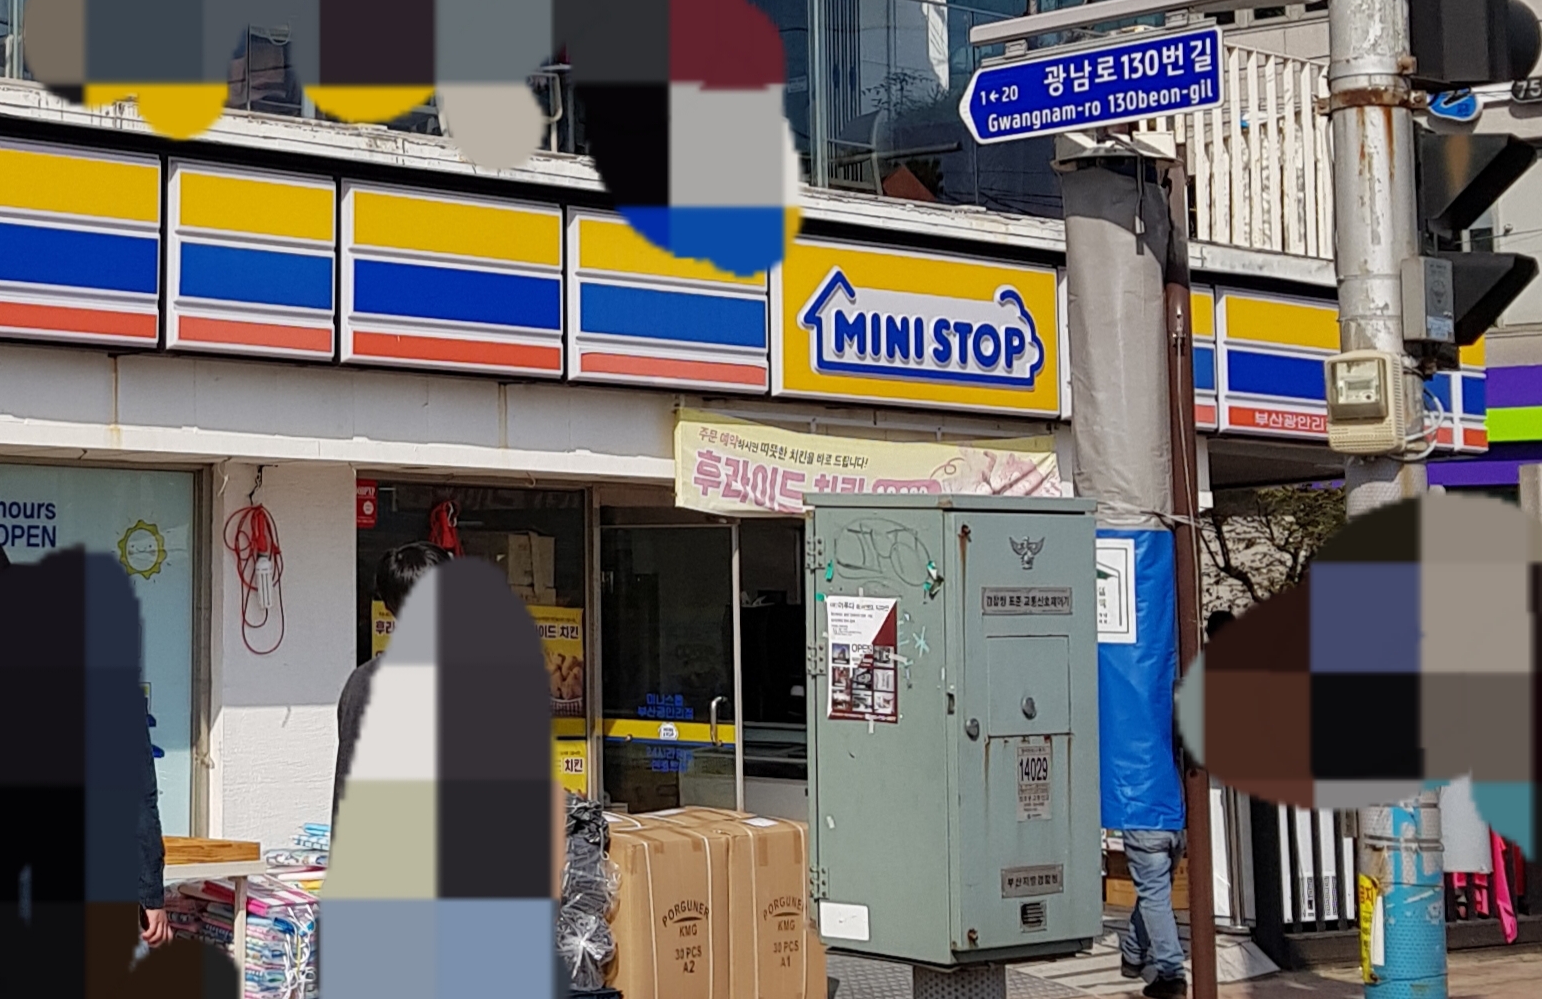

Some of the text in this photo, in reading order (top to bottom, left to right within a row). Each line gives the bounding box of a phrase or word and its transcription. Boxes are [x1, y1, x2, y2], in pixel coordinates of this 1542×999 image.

[1043, 37, 1213, 97] 광남로130번길
[988, 78, 1213, 133] Gwangnam-ro 130beon-gil
[1254, 410, 1328, 431] 부산광안리
[699, 426, 718, 443] 주문
[760, 442, 788, 461] 따뜻한
[789, 449, 815, 465] 치킨을
[816, 453, 833, 467] 바로
[693, 450, 806, 513] 후라이드
[559, 625, 579, 639] 치킨
[564, 758, 583, 773] 치킨
[1019, 757, 1048, 782] 14029
[662, 900, 709, 927] PORGUNER
[679, 923, 698, 937] KMG
[777, 919, 796, 931] KMG
[686, 945, 702, 958] PCS
[783, 940, 799, 952] PCS
[683, 960, 695, 973] A2
[780, 956, 791, 967] A1
